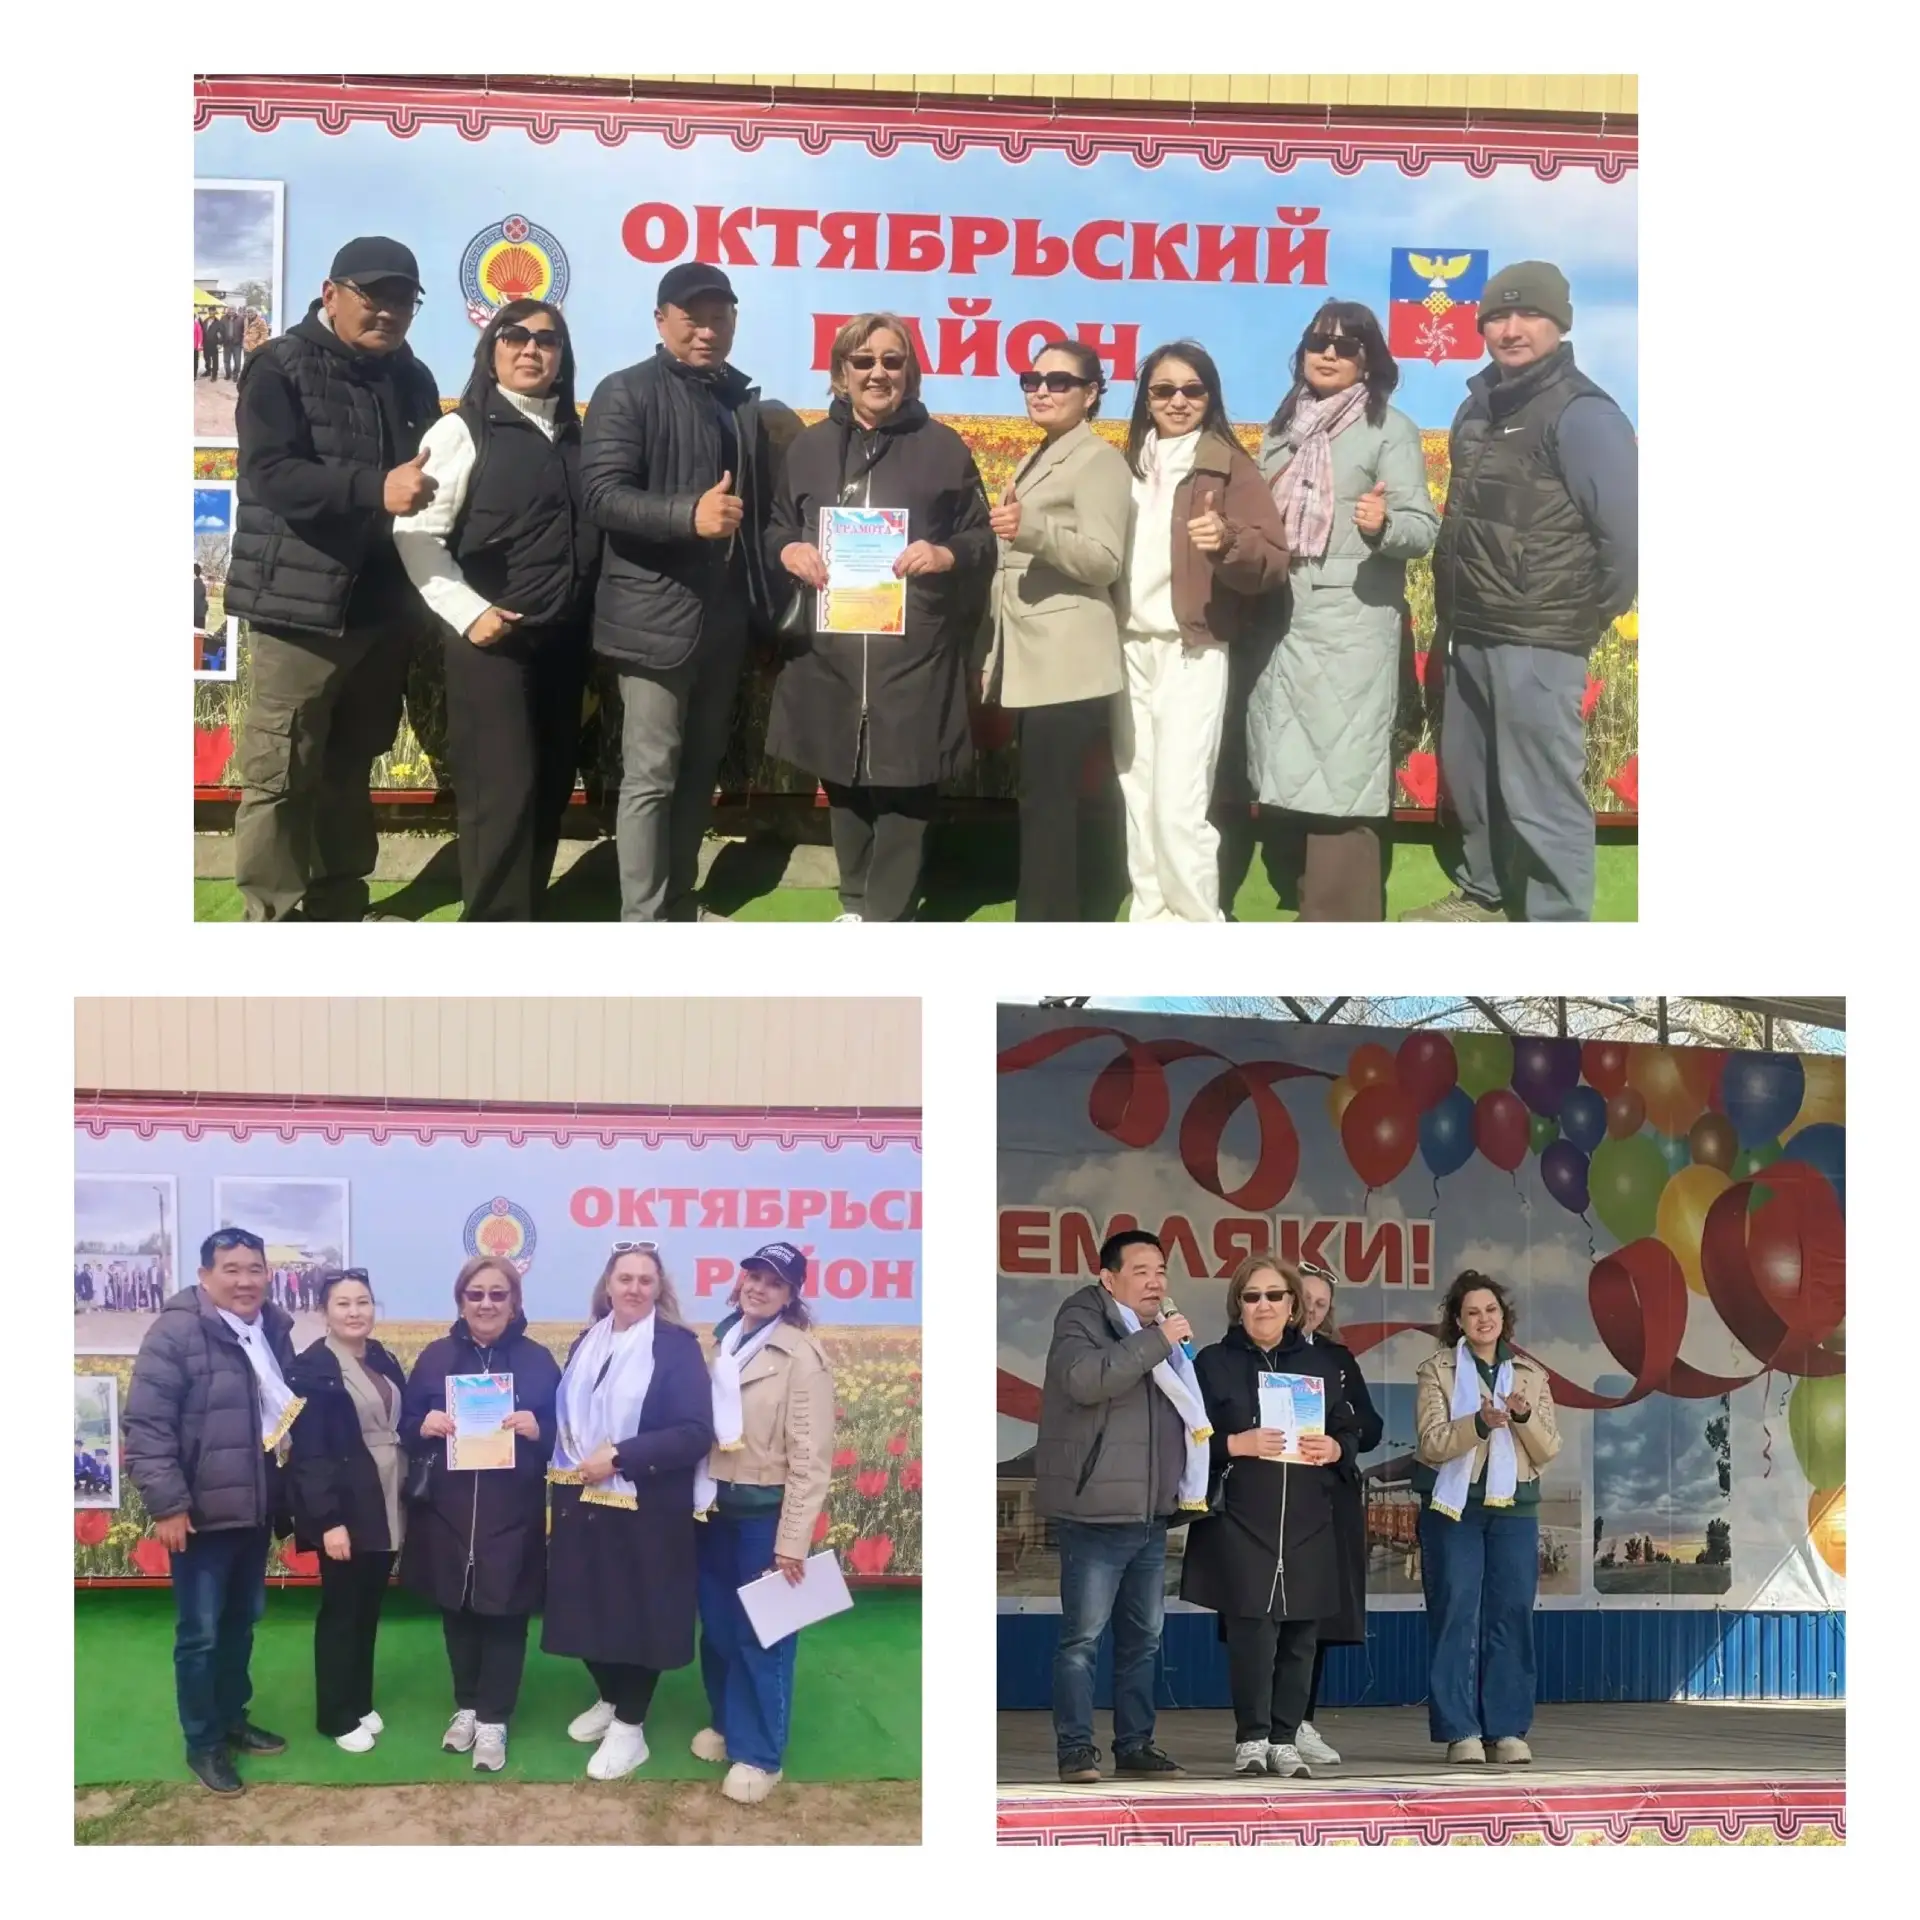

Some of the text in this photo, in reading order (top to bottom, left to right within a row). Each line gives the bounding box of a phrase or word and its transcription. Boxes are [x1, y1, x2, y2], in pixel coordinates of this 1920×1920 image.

[621, 202, 1330, 286] ОКТЯБРЬСКИЙ
[835, 523, 893, 535] ГРАМОТА
[569, 1186, 922, 1231] ОКТЯБРЬС
[694, 1245, 915, 1300] РОН
